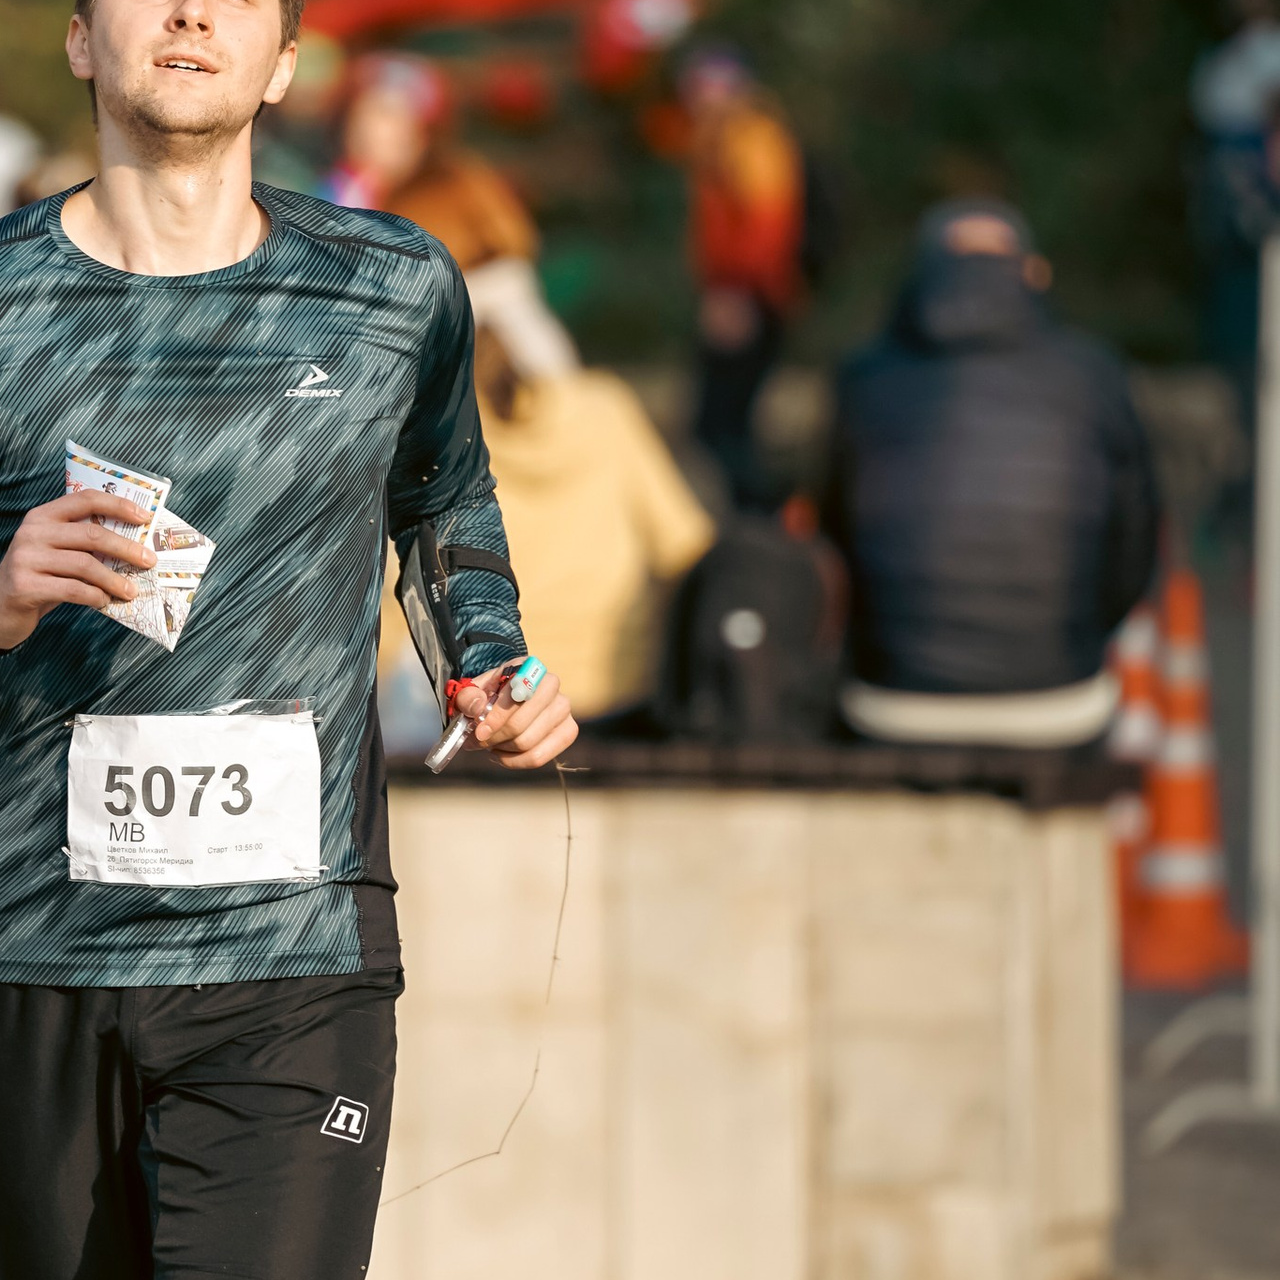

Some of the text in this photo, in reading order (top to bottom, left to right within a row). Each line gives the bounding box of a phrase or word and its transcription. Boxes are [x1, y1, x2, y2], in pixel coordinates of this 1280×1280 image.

[284, 389, 343, 398] DEMIX
[103, 763, 253, 818] 5073
[139, 846, 169, 854] Михаил
